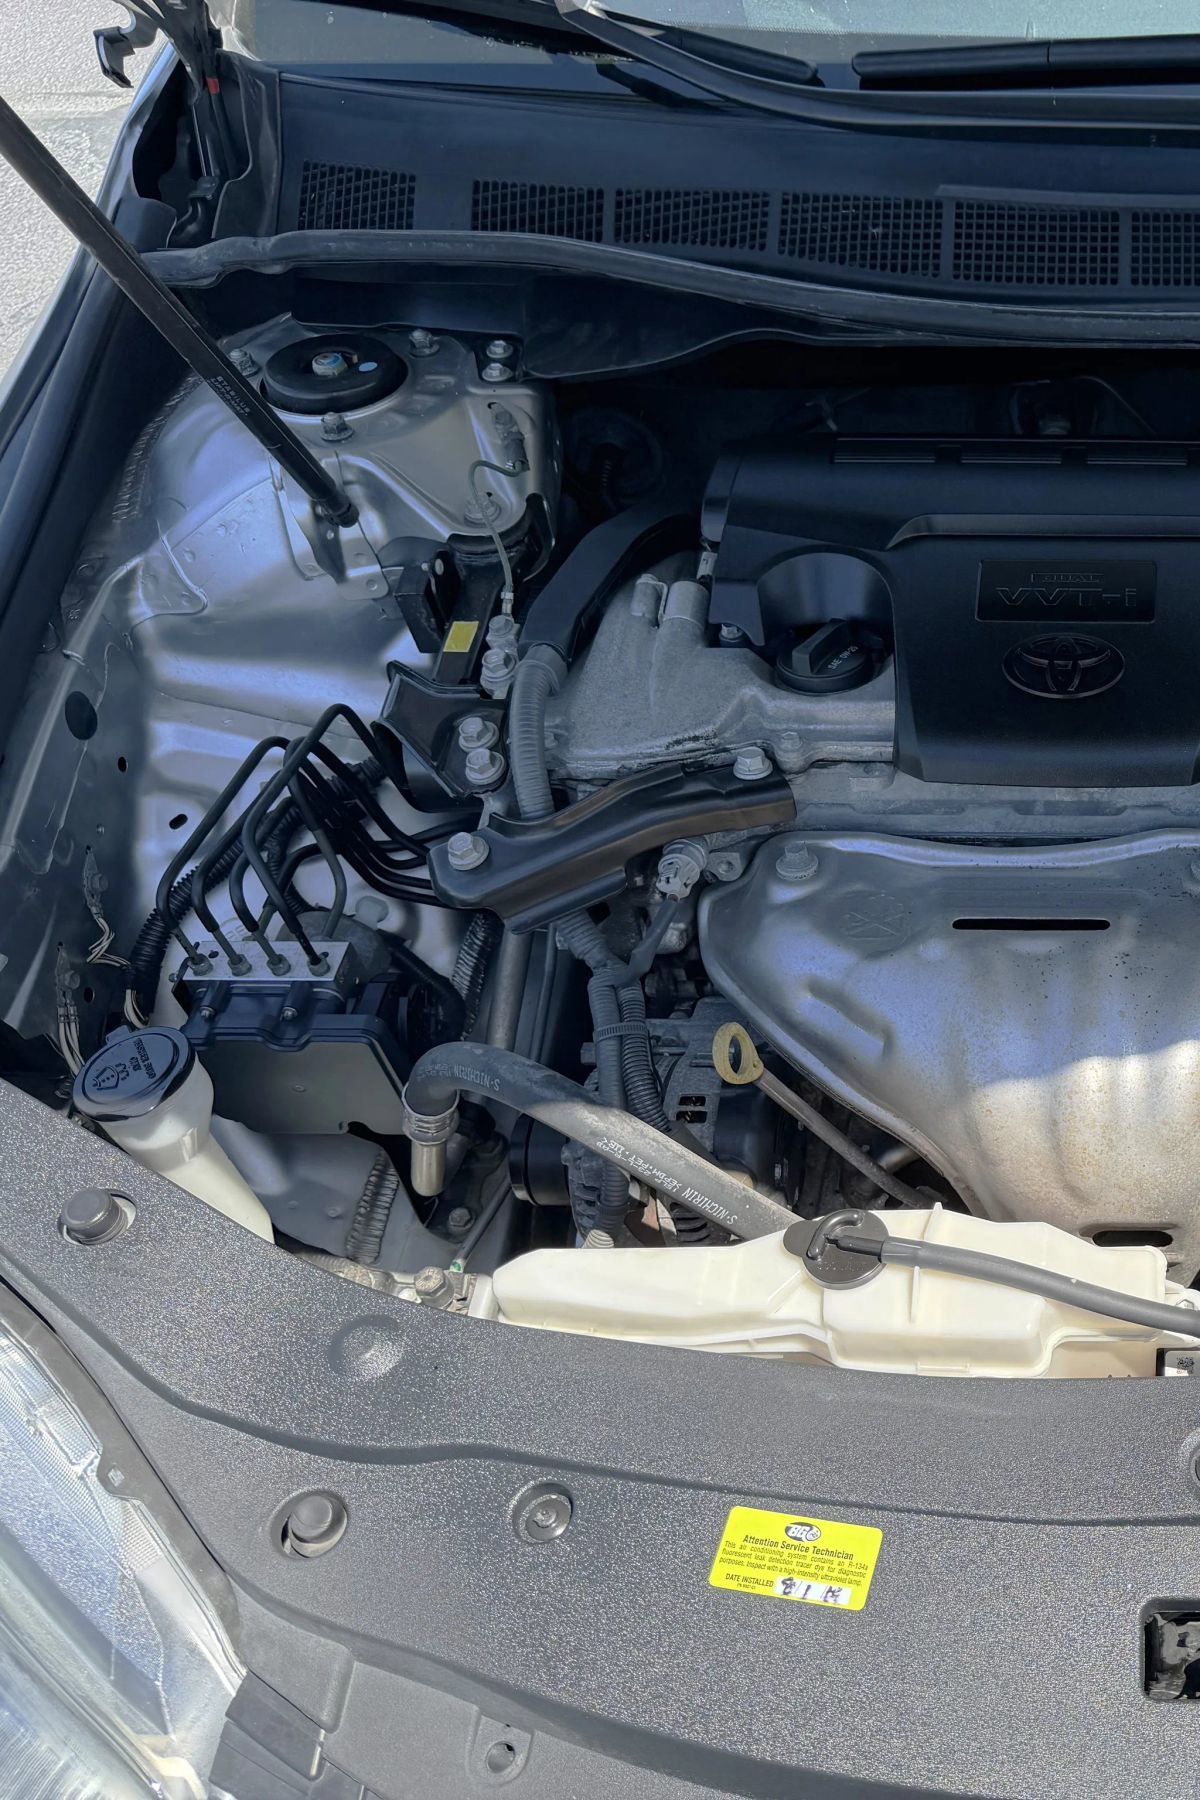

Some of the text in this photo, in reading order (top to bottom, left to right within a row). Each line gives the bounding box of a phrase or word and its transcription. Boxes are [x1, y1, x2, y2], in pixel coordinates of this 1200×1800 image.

[724, 1540, 737, 1548] This
[750, 1545, 784, 1558] conditioning
[787, 1550, 808, 1561] system
[810, 1554, 834, 1565] contains
[847, 1560, 869, 1571] R-134a
[743, 1534, 854, 1561] Attention Service Technician
[718, 1557, 745, 1569] purposes.
[746, 1561, 766, 1572] Inspect
[766, 1563, 778, 1572] with
[783, 1567, 820, 1581] high-intensity
[820, 1572, 847, 1584] ultraviolet
[847, 1577, 862, 1587] lamp.
[721, 1548, 866, 1578] fluorescent leak detection tracer dye for diagnostic
[725, 1573, 741, 1582] DATE
[741, 1575, 774, 1587] INSTALLED
